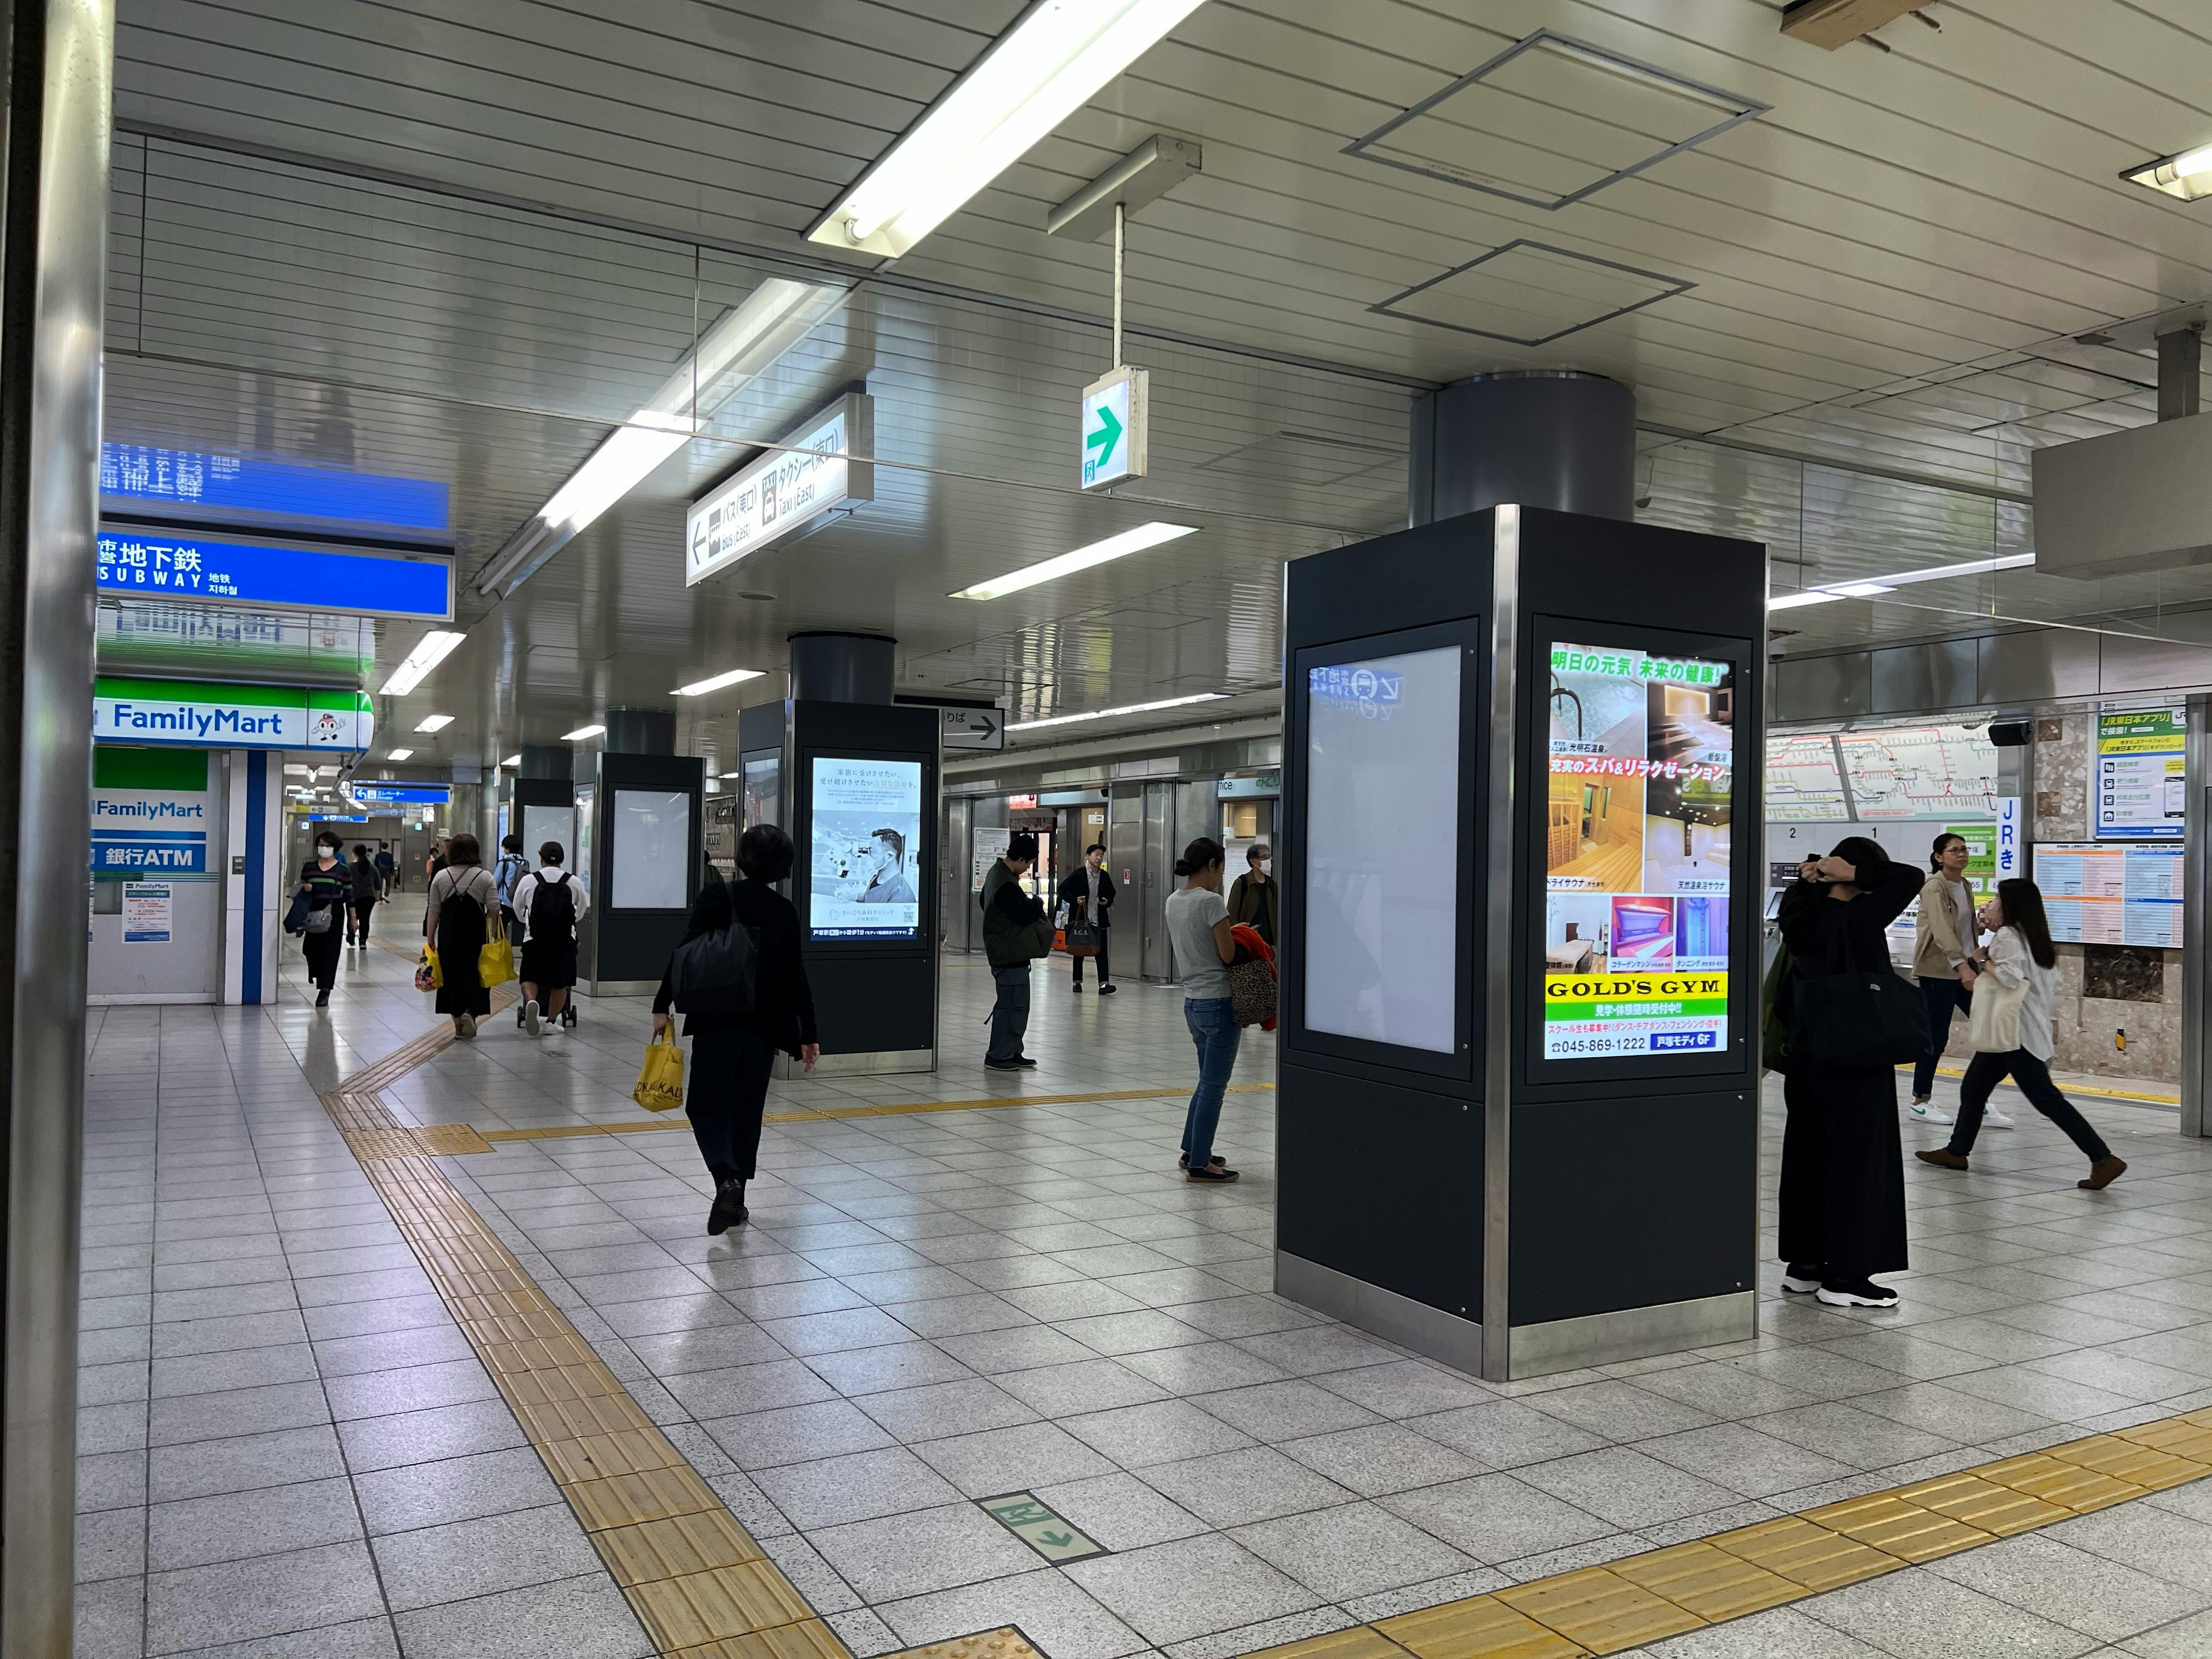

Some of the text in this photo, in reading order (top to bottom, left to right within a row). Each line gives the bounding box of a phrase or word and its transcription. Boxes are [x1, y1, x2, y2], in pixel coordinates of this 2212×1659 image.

[99, 566, 201, 588] SUBWAY
[208, 573, 230, 584] 地铁
[208, 585, 238, 596] 지하철
[1551, 651, 1632, 677] 明日の元気
[114, 704, 283, 737] FamilyMart
[944, 712, 966, 723] りば
[97, 800, 203, 820] FamilyMart
[1790, 828, 1796, 838] 2
[1871, 827, 1877, 838] 1
[106, 848, 193, 866] 銀行ATM
[1547, 979, 1721, 997] GOLD'S GYM
